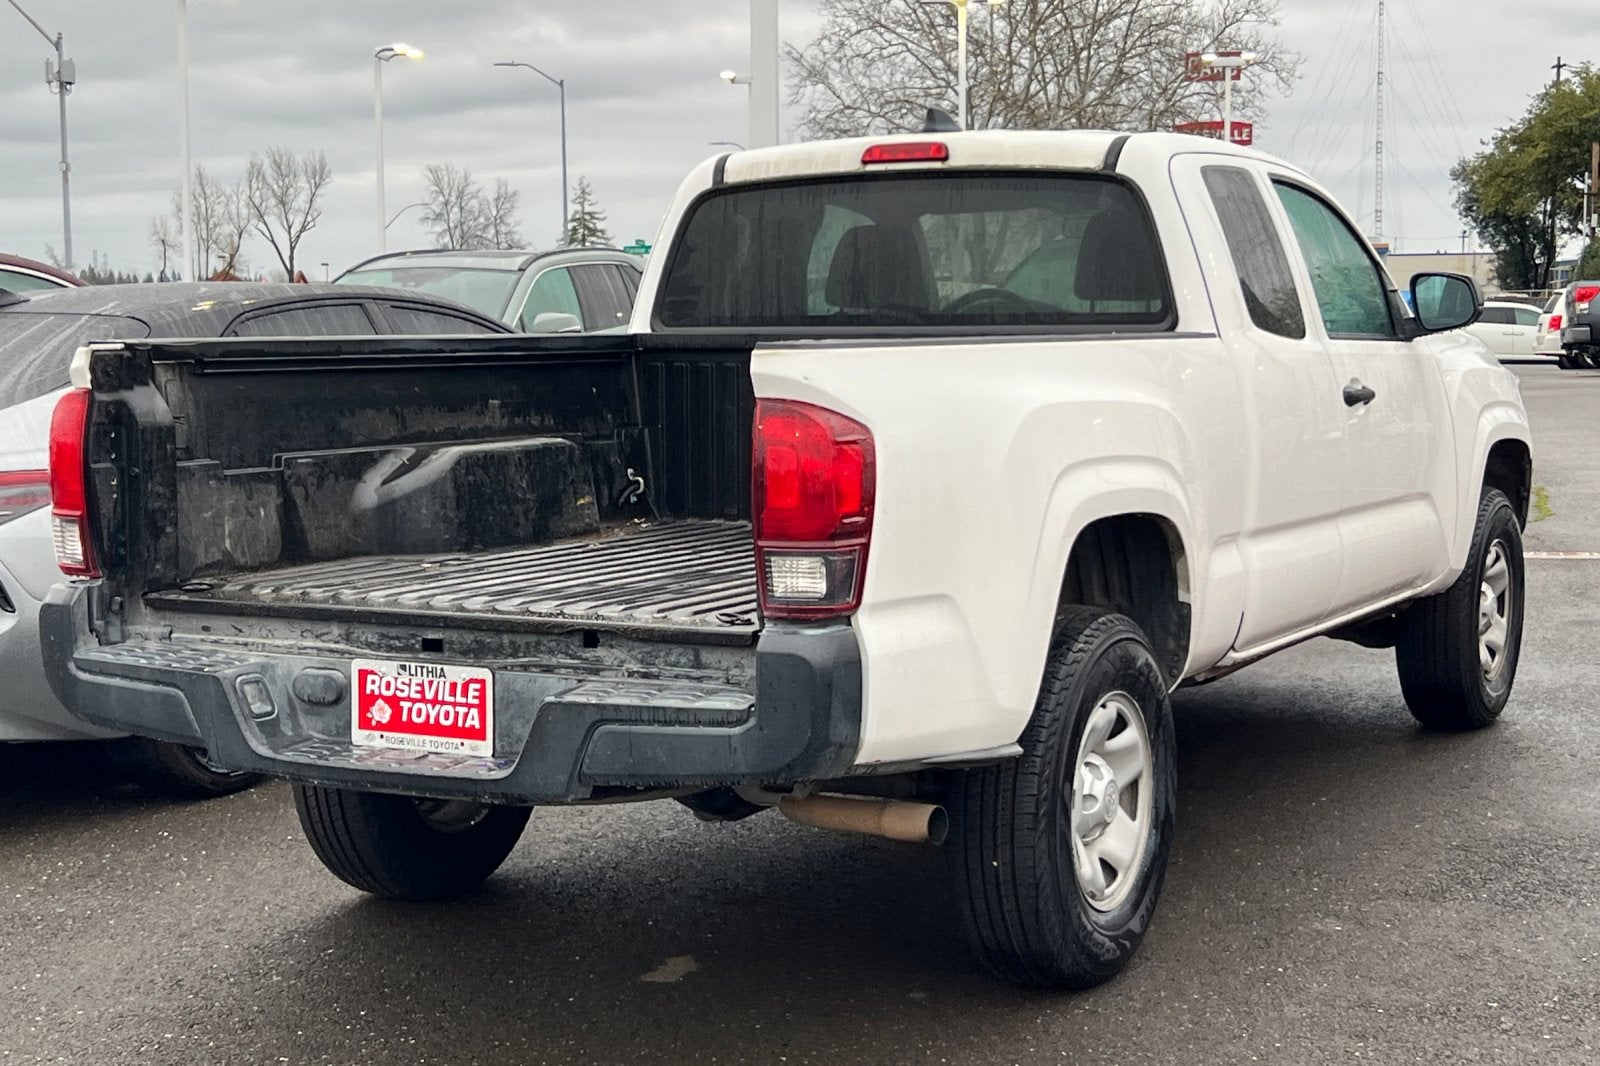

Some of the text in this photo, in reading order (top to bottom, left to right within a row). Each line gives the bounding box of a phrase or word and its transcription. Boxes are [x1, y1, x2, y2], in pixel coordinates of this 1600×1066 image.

[408, 664, 447, 679] LITHIA
[365, 674, 481, 705] ROSEVILLE
[399, 701, 480, 730] TOYOTA
[385, 735, 460, 751] ROSEVILLE TOYOTA
